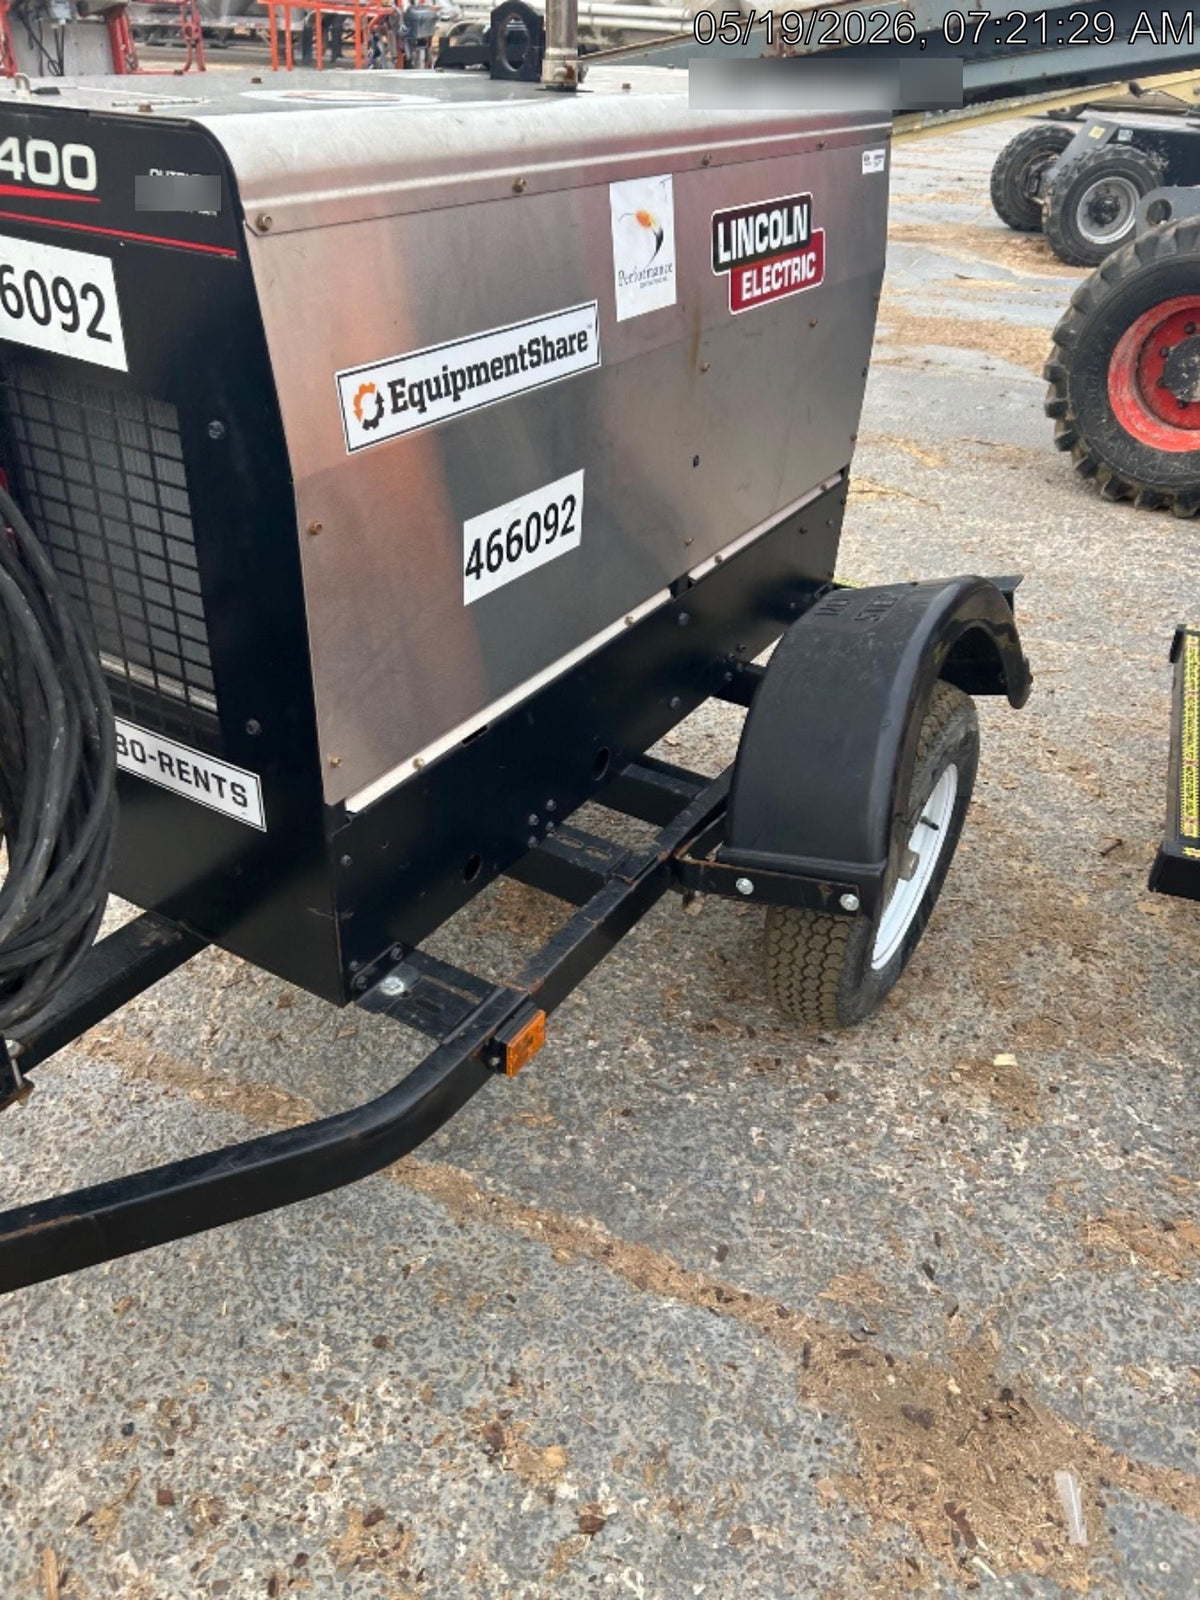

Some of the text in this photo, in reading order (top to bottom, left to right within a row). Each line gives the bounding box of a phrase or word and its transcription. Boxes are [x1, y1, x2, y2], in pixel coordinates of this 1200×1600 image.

[0, 136, 98, 192] 400
[717, 203, 808, 264] LINCOLN
[0, 263, 113, 344] 6092
[741, 251, 817, 302] ELECTRIC
[387, 329, 589, 415] EquipmentShare
[464, 493, 578, 581] 466092
